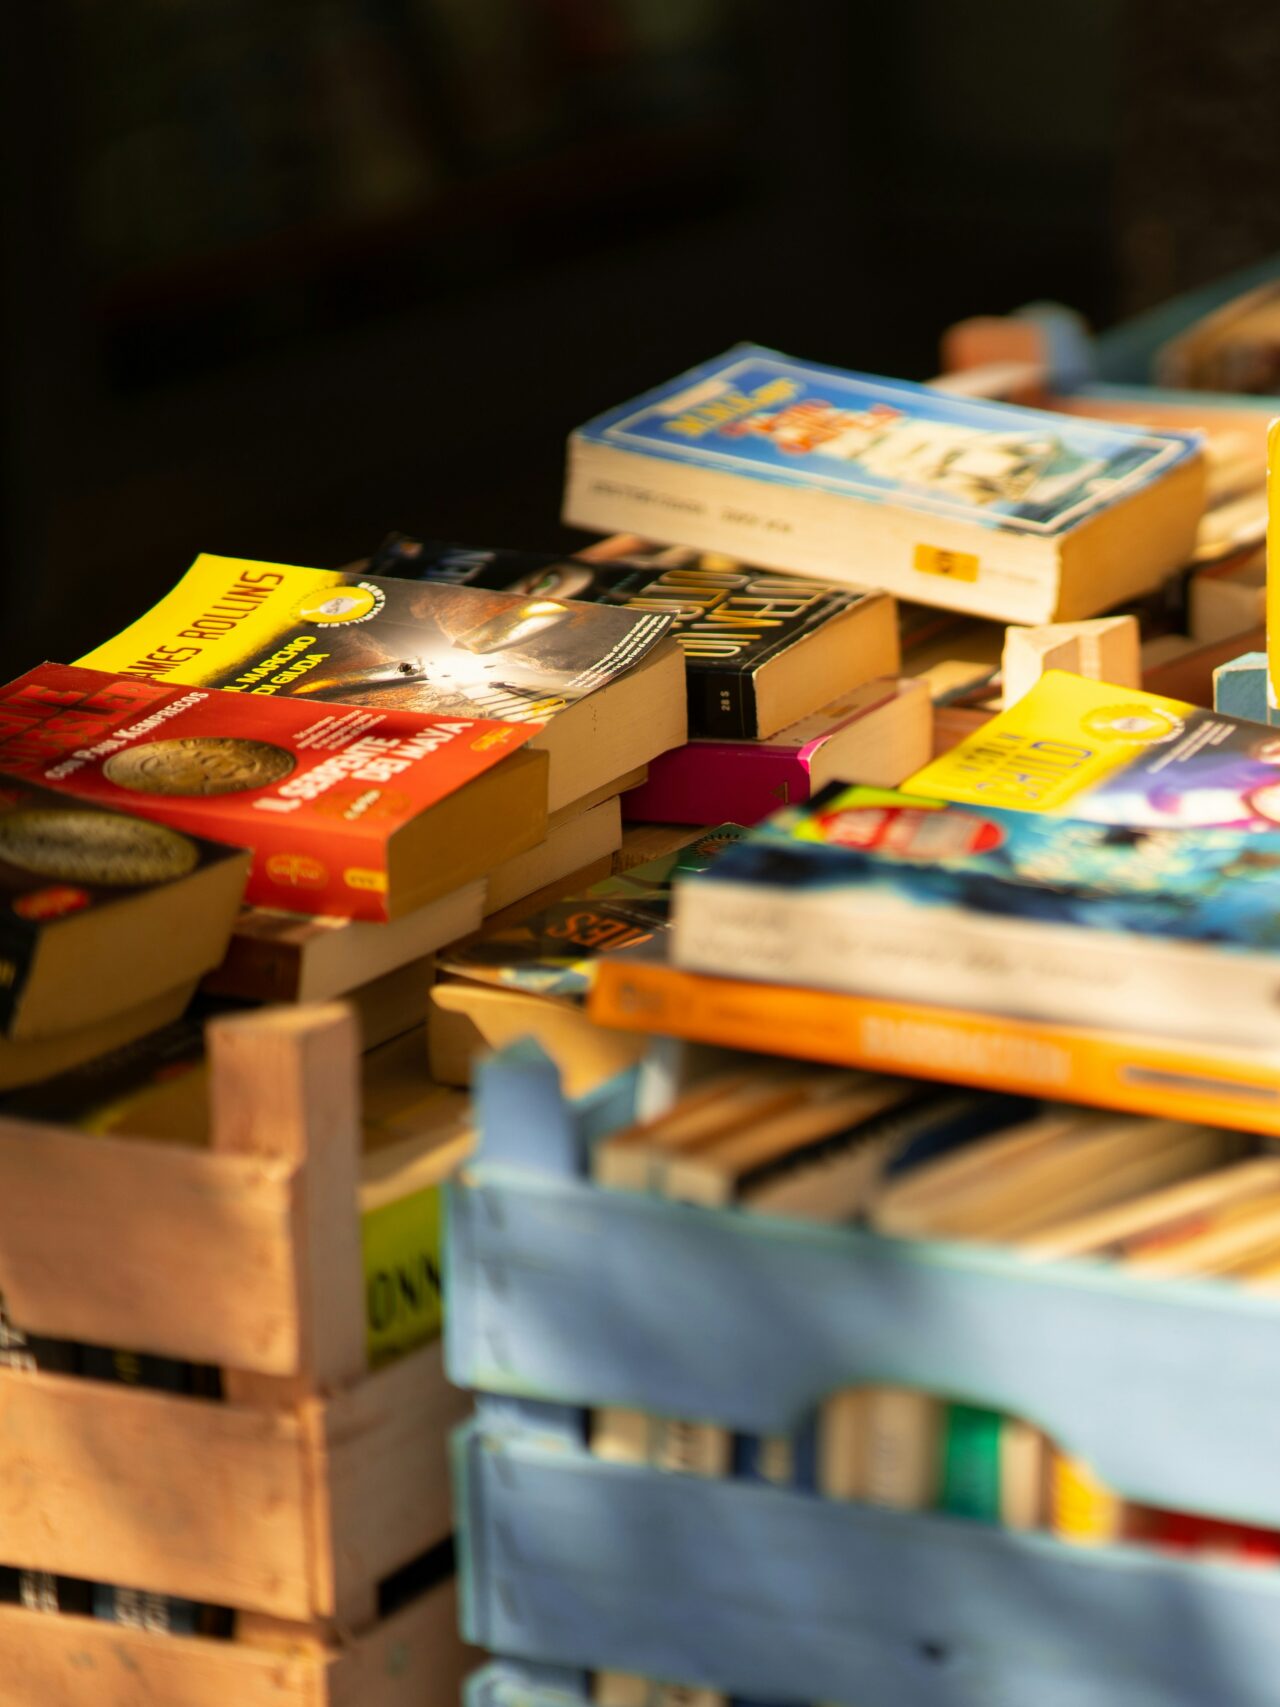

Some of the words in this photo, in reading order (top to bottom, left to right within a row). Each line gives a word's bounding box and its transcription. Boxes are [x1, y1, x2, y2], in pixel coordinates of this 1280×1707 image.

[177, 569, 285, 641] ROLLINS
[242, 635, 317, 682] MARCHIO
[270, 652, 332, 687] GIUDA
[389, 721, 475, 760] MAYA
[251, 797, 302, 813] IL
[277, 735, 401, 800] SERPENTE
